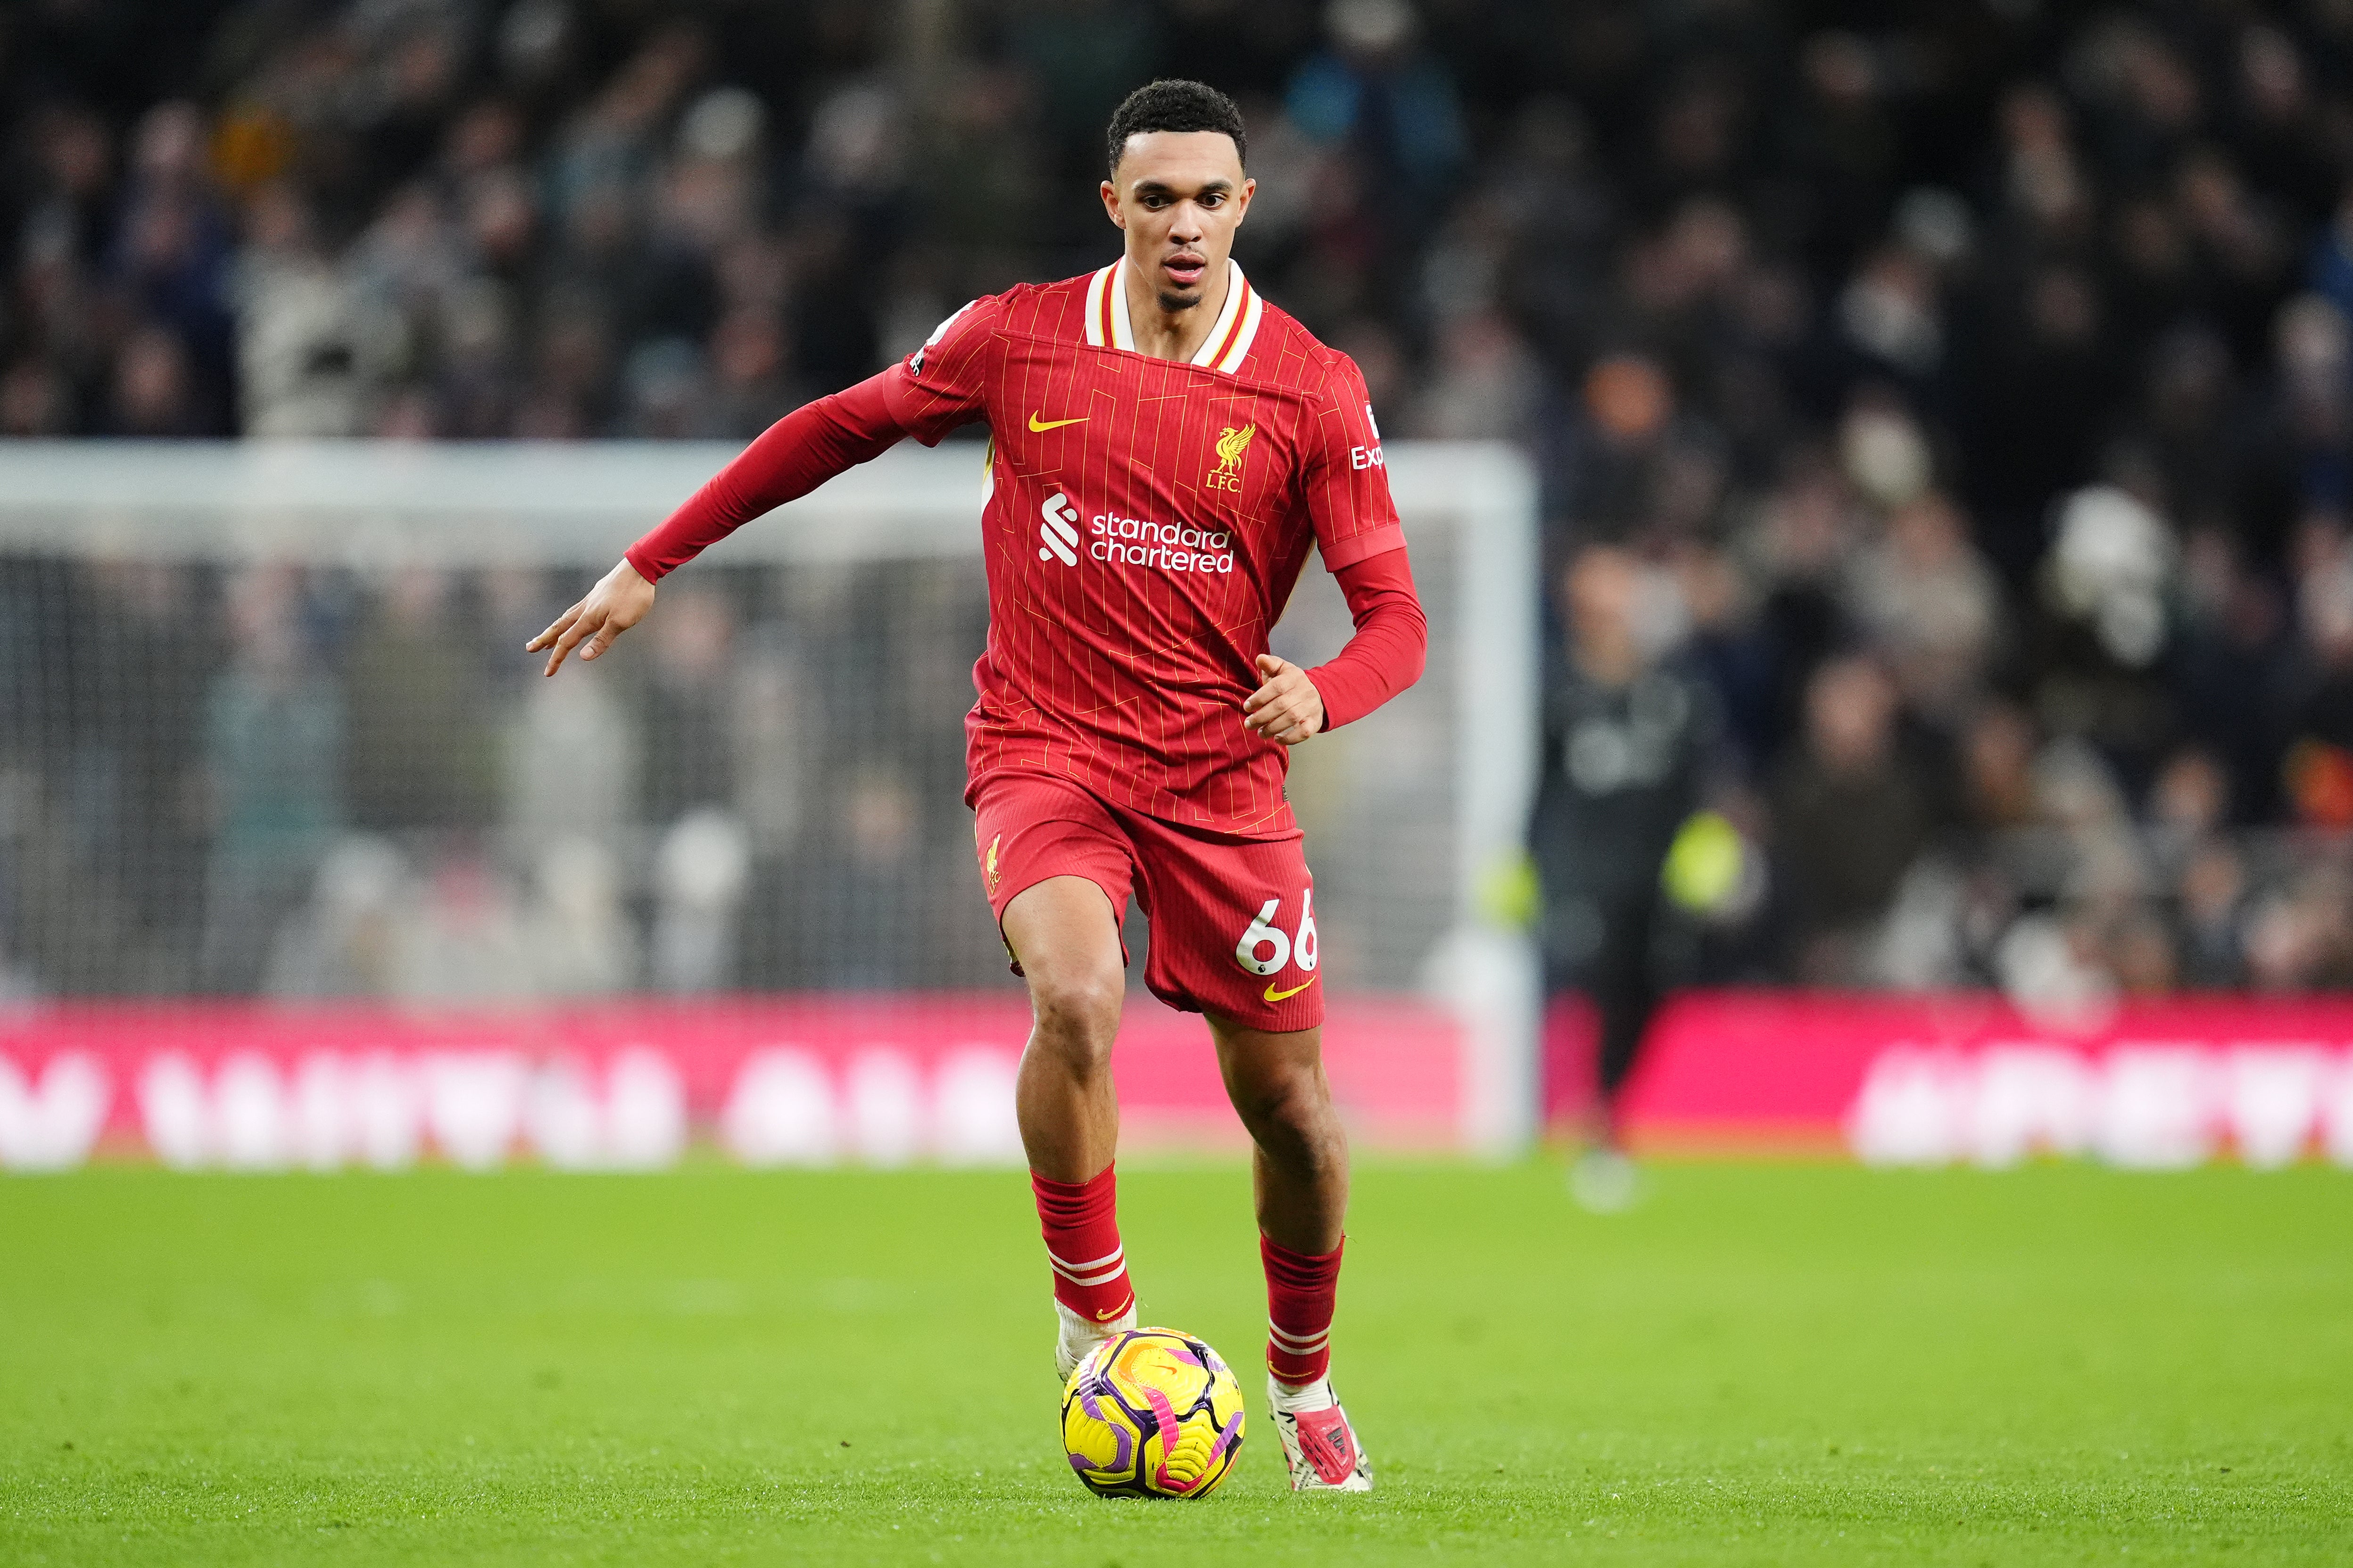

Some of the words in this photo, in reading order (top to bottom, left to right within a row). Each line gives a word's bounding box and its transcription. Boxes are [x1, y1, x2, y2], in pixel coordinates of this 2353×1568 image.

[1205, 473, 1241, 493] L.F.C.
[1091, 512, 1231, 549] standard
[1091, 537, 1234, 574] chartered
[1235, 888, 1317, 975] 66
